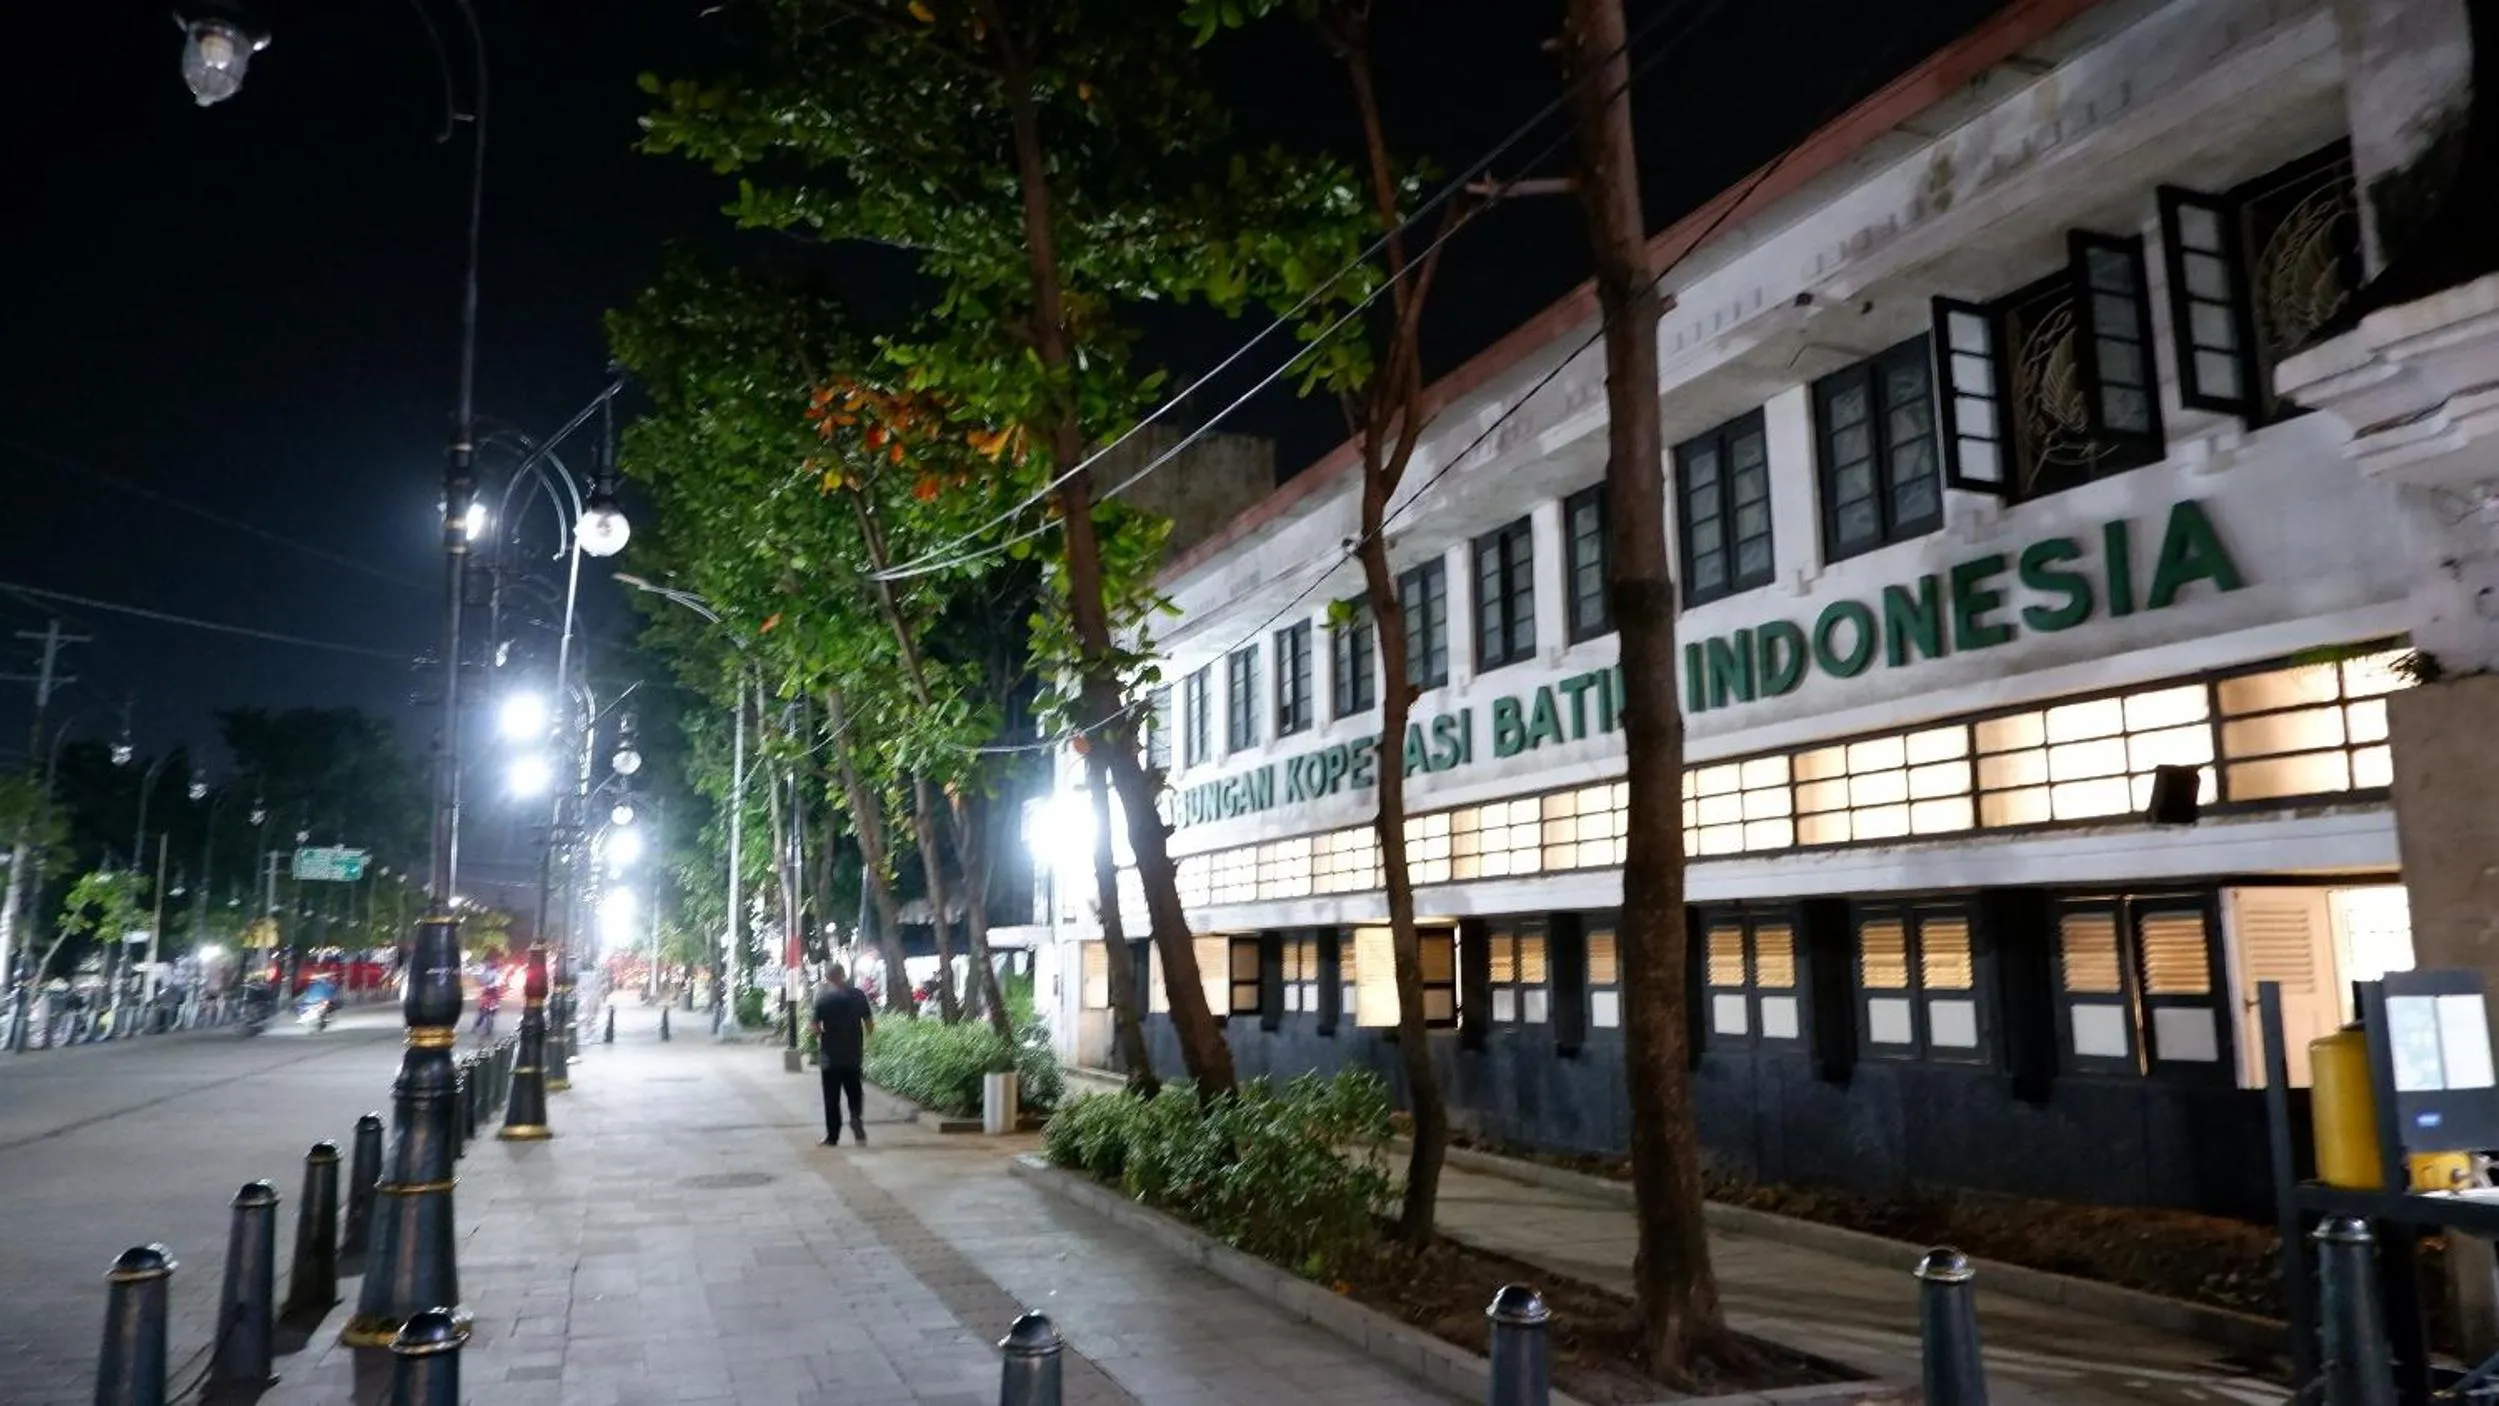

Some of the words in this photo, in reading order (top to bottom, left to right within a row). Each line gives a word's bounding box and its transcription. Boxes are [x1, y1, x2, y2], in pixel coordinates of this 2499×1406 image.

[1162, 764, 1275, 828] BUNGAN
[1285, 708, 1472, 803] KOPEASI
[1685, 499, 2243, 713] INDONESIA
